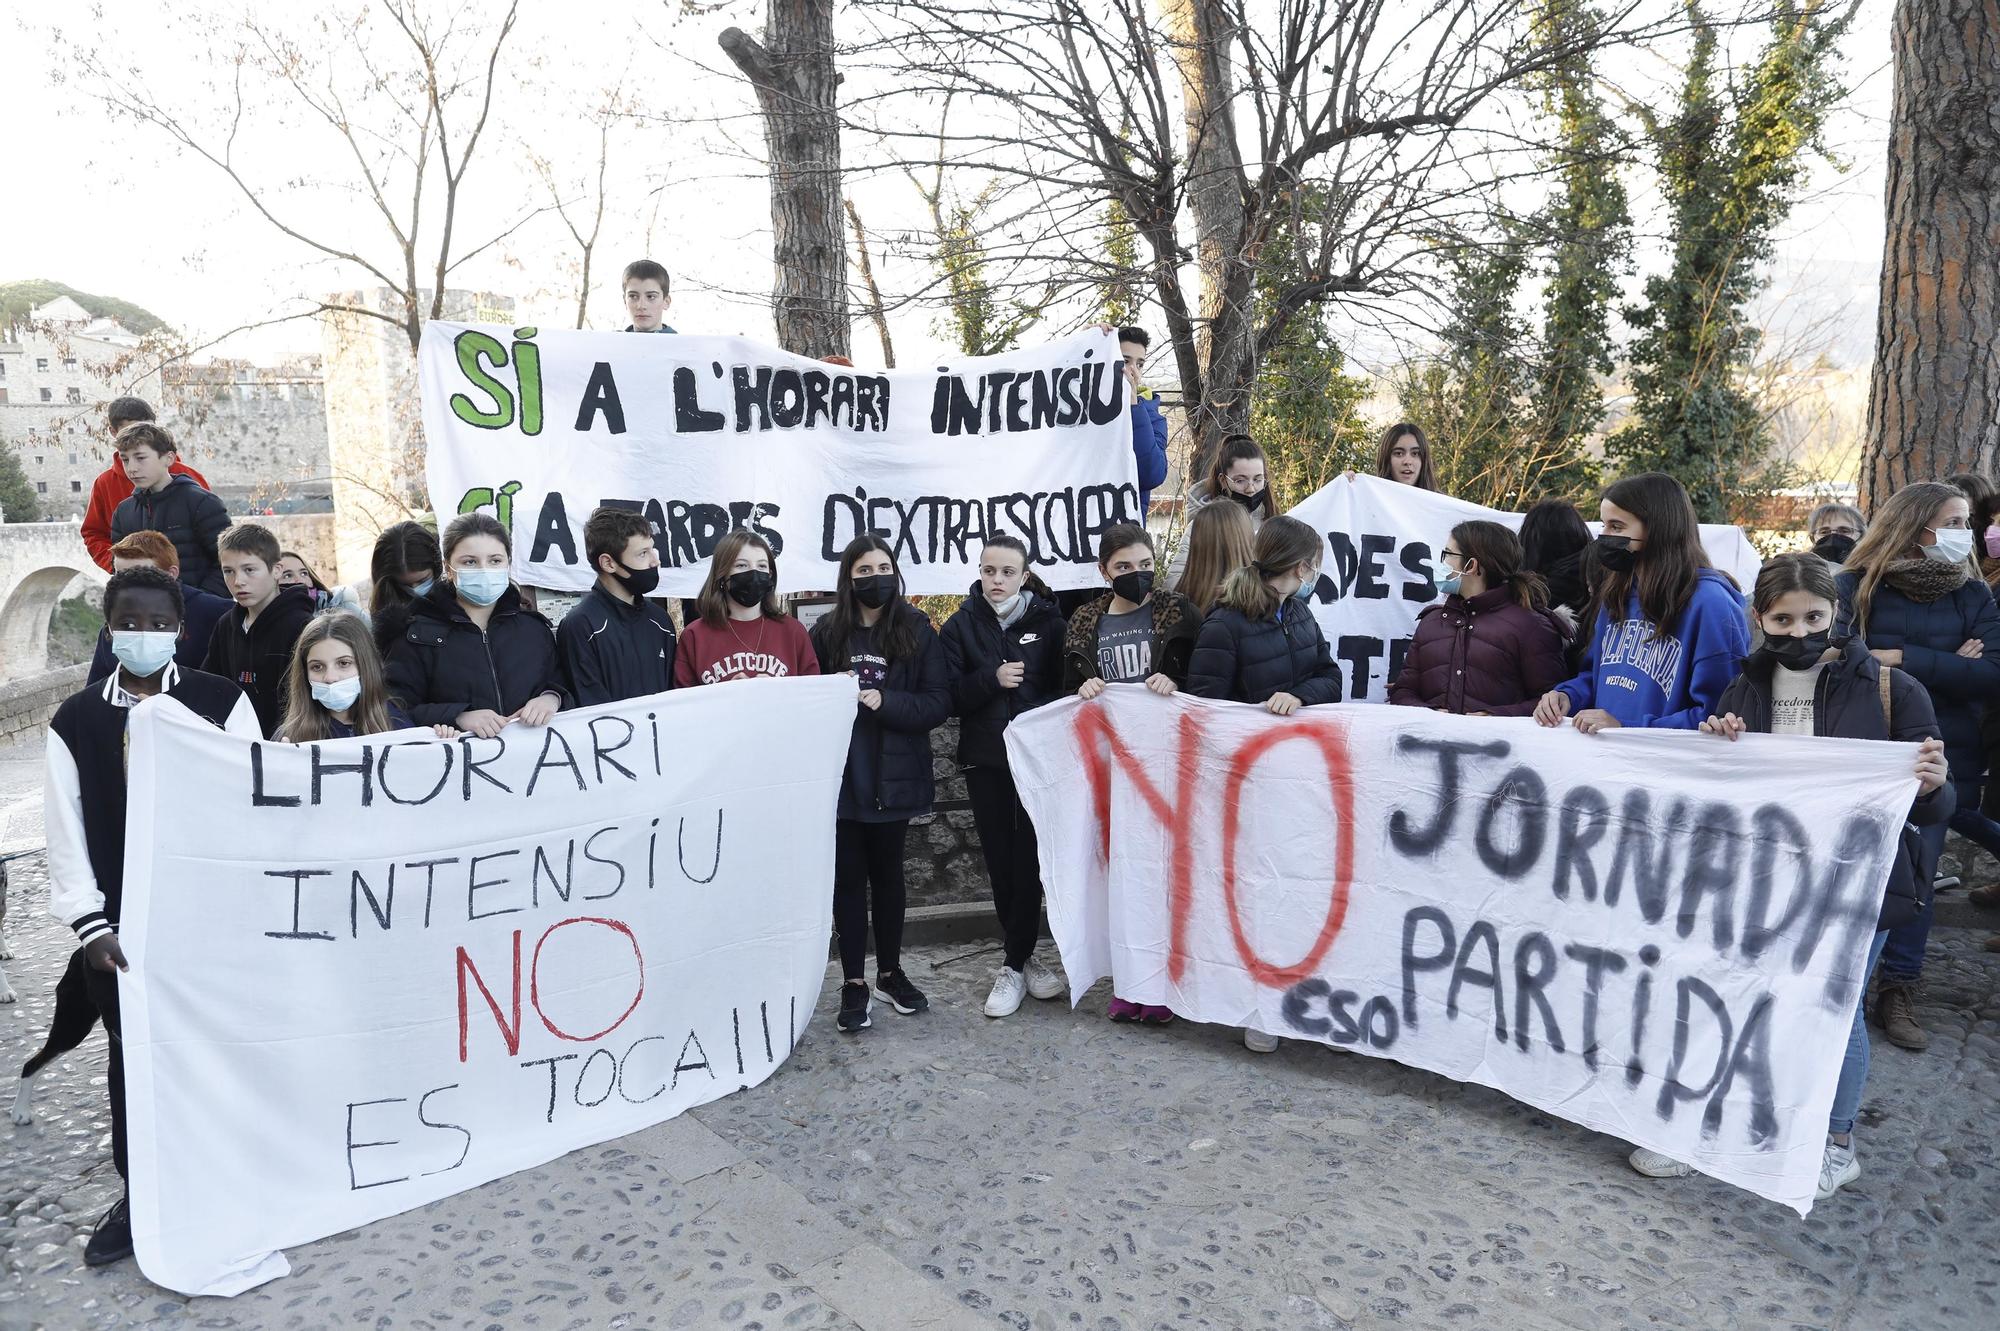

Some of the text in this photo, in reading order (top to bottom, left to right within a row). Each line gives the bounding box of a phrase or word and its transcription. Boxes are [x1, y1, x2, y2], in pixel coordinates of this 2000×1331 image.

[450, 327, 544, 437] SÍ
[574, 361, 627, 435] A
[529, 491, 579, 566] A
[1097, 640, 1152, 681] RIDA
[1112, 628, 1143, 638] WAITING
[1619, 676, 1638, 691] COAST
[1772, 696, 1815, 707] reedom
[1072, 701, 1890, 1008] NO JORNADA
[457, 917, 643, 1062] NO
[1282, 978, 1398, 1049] ESO
[1403, 906, 1779, 1146] PARTIDA
[347, 1083, 471, 1190] ES
